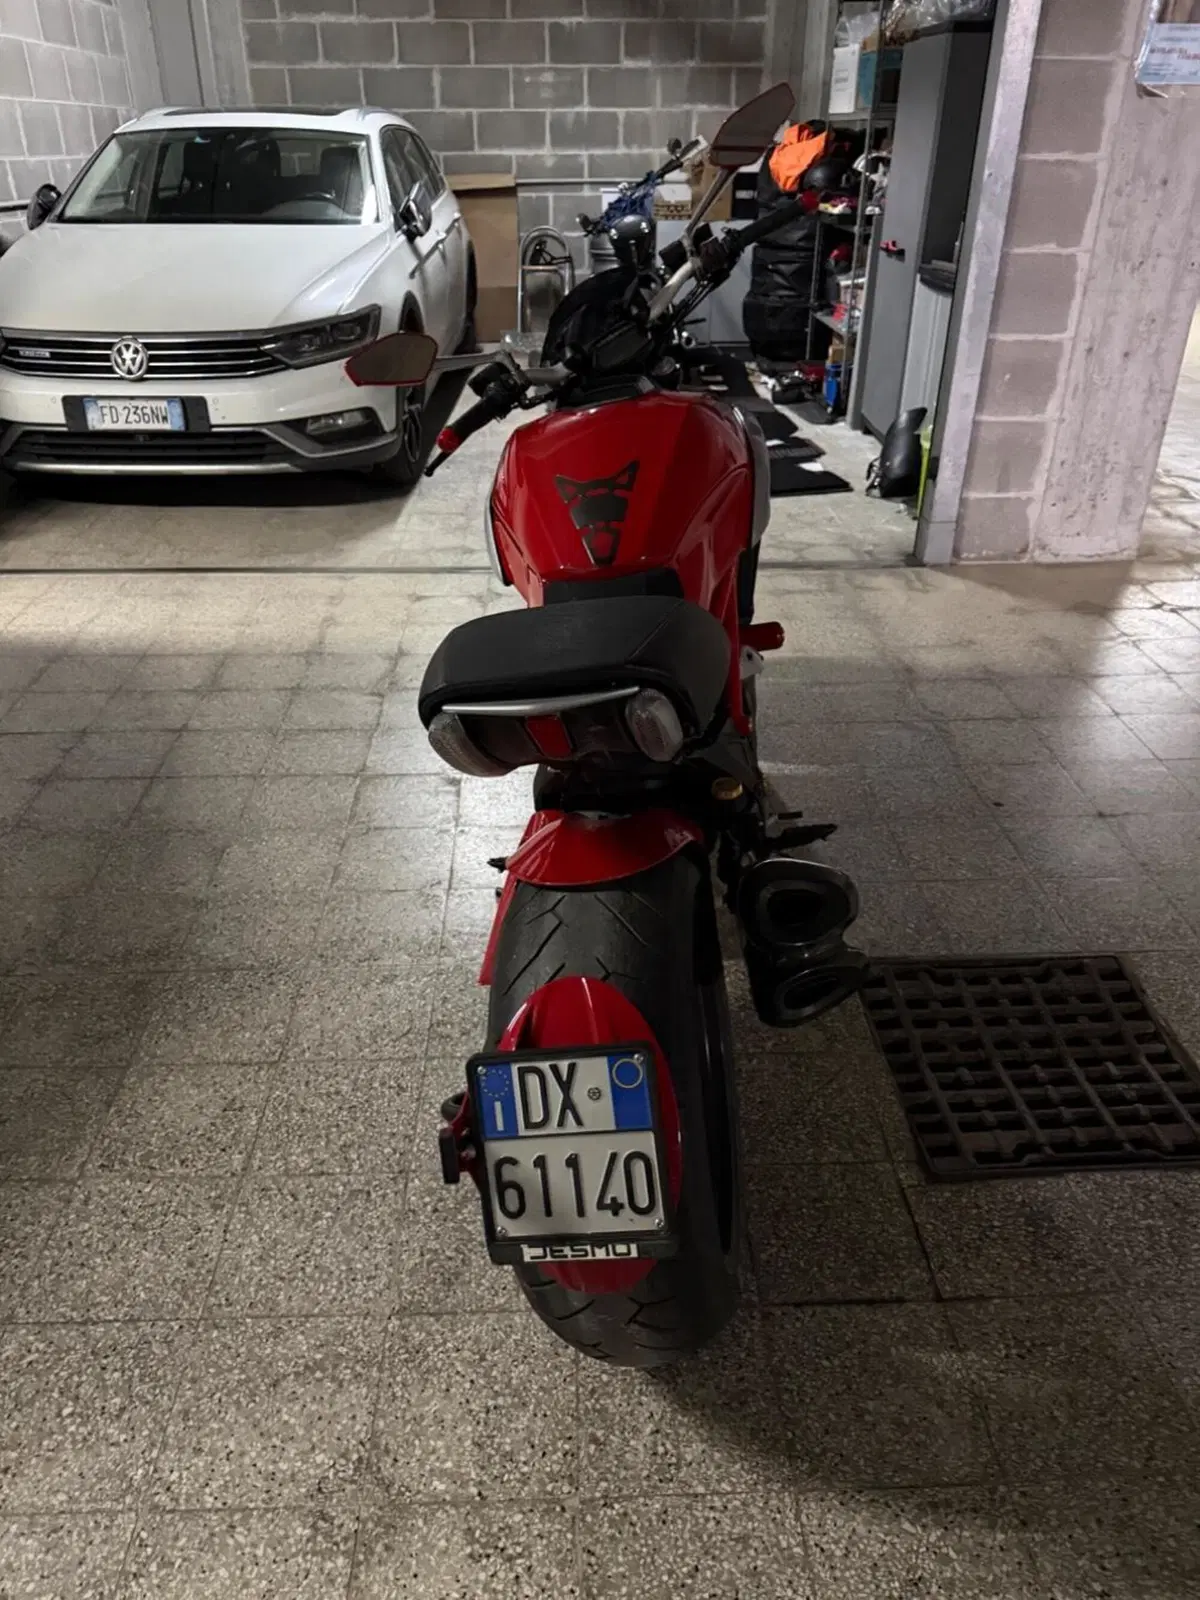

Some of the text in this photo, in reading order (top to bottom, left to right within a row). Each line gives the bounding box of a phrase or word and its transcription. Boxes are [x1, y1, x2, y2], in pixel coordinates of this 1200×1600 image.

[100, 405, 169, 424] FD 236NW
[517, 1062, 584, 1129] DX
[494, 1151, 657, 1220] 61140
